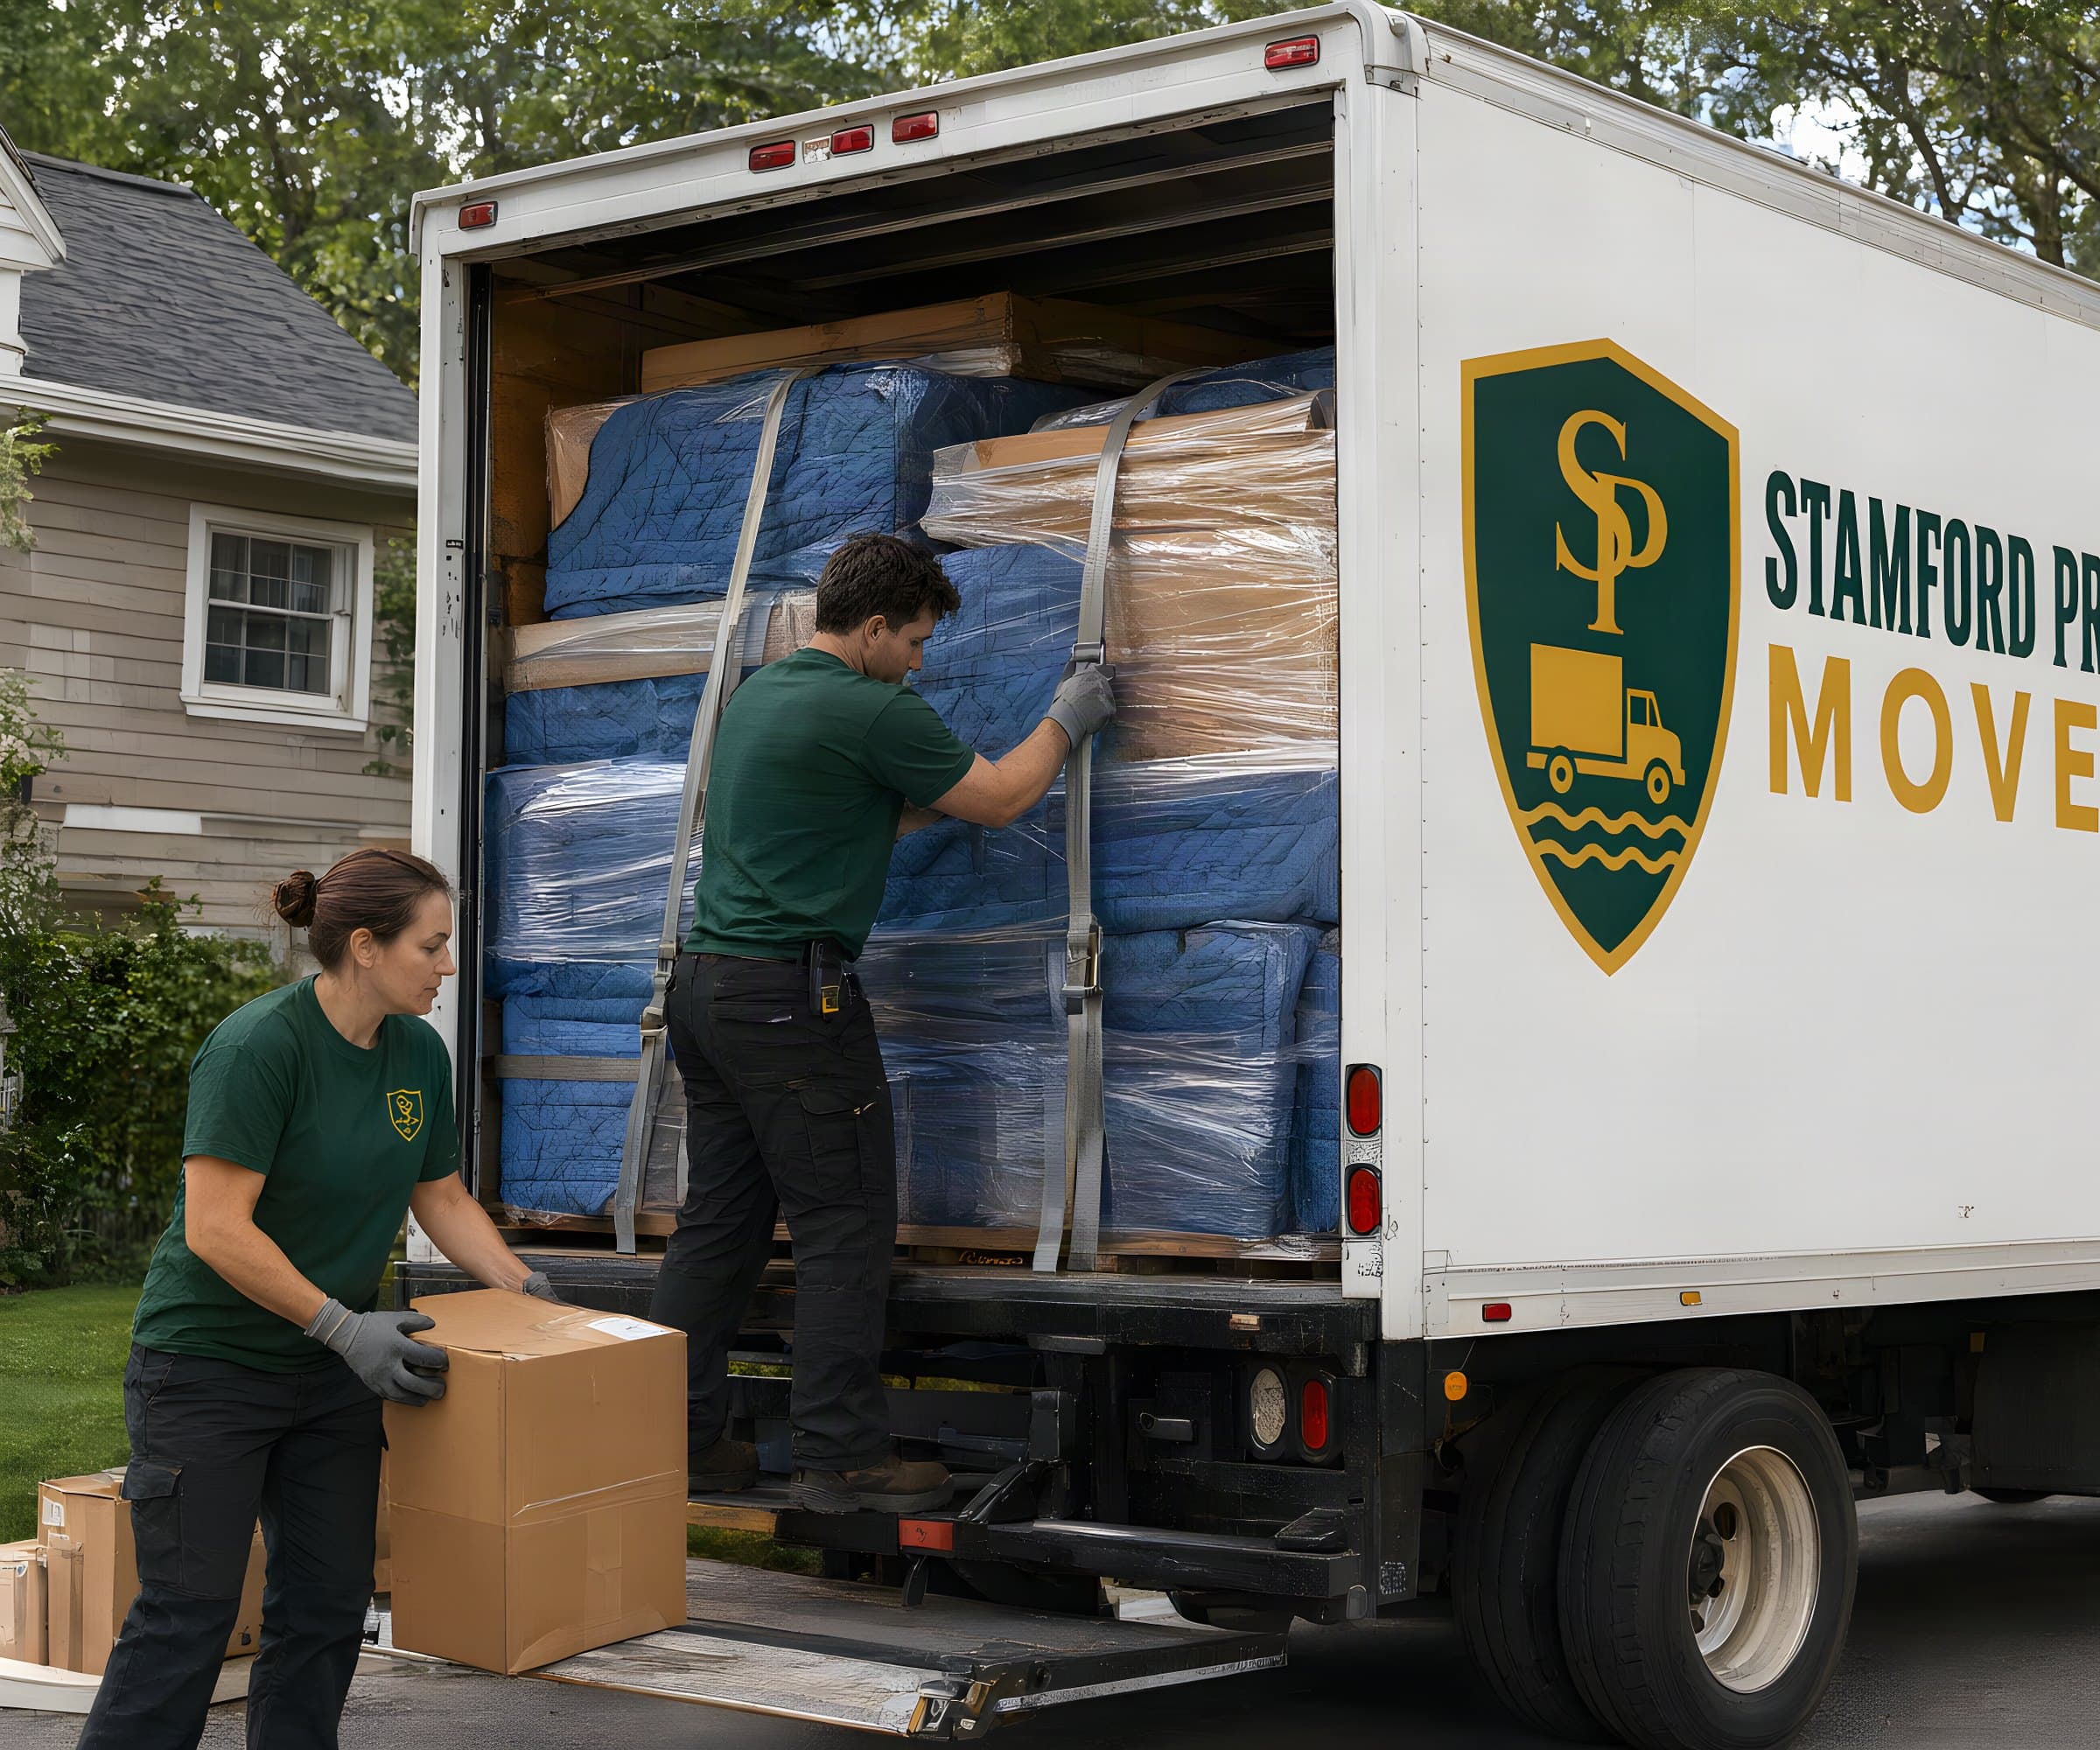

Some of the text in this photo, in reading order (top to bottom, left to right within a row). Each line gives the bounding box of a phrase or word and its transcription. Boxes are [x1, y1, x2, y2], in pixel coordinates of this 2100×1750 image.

[1765, 470, 2100, 675] STAMFORD PR
[1768, 643, 2099, 833] MOVE
